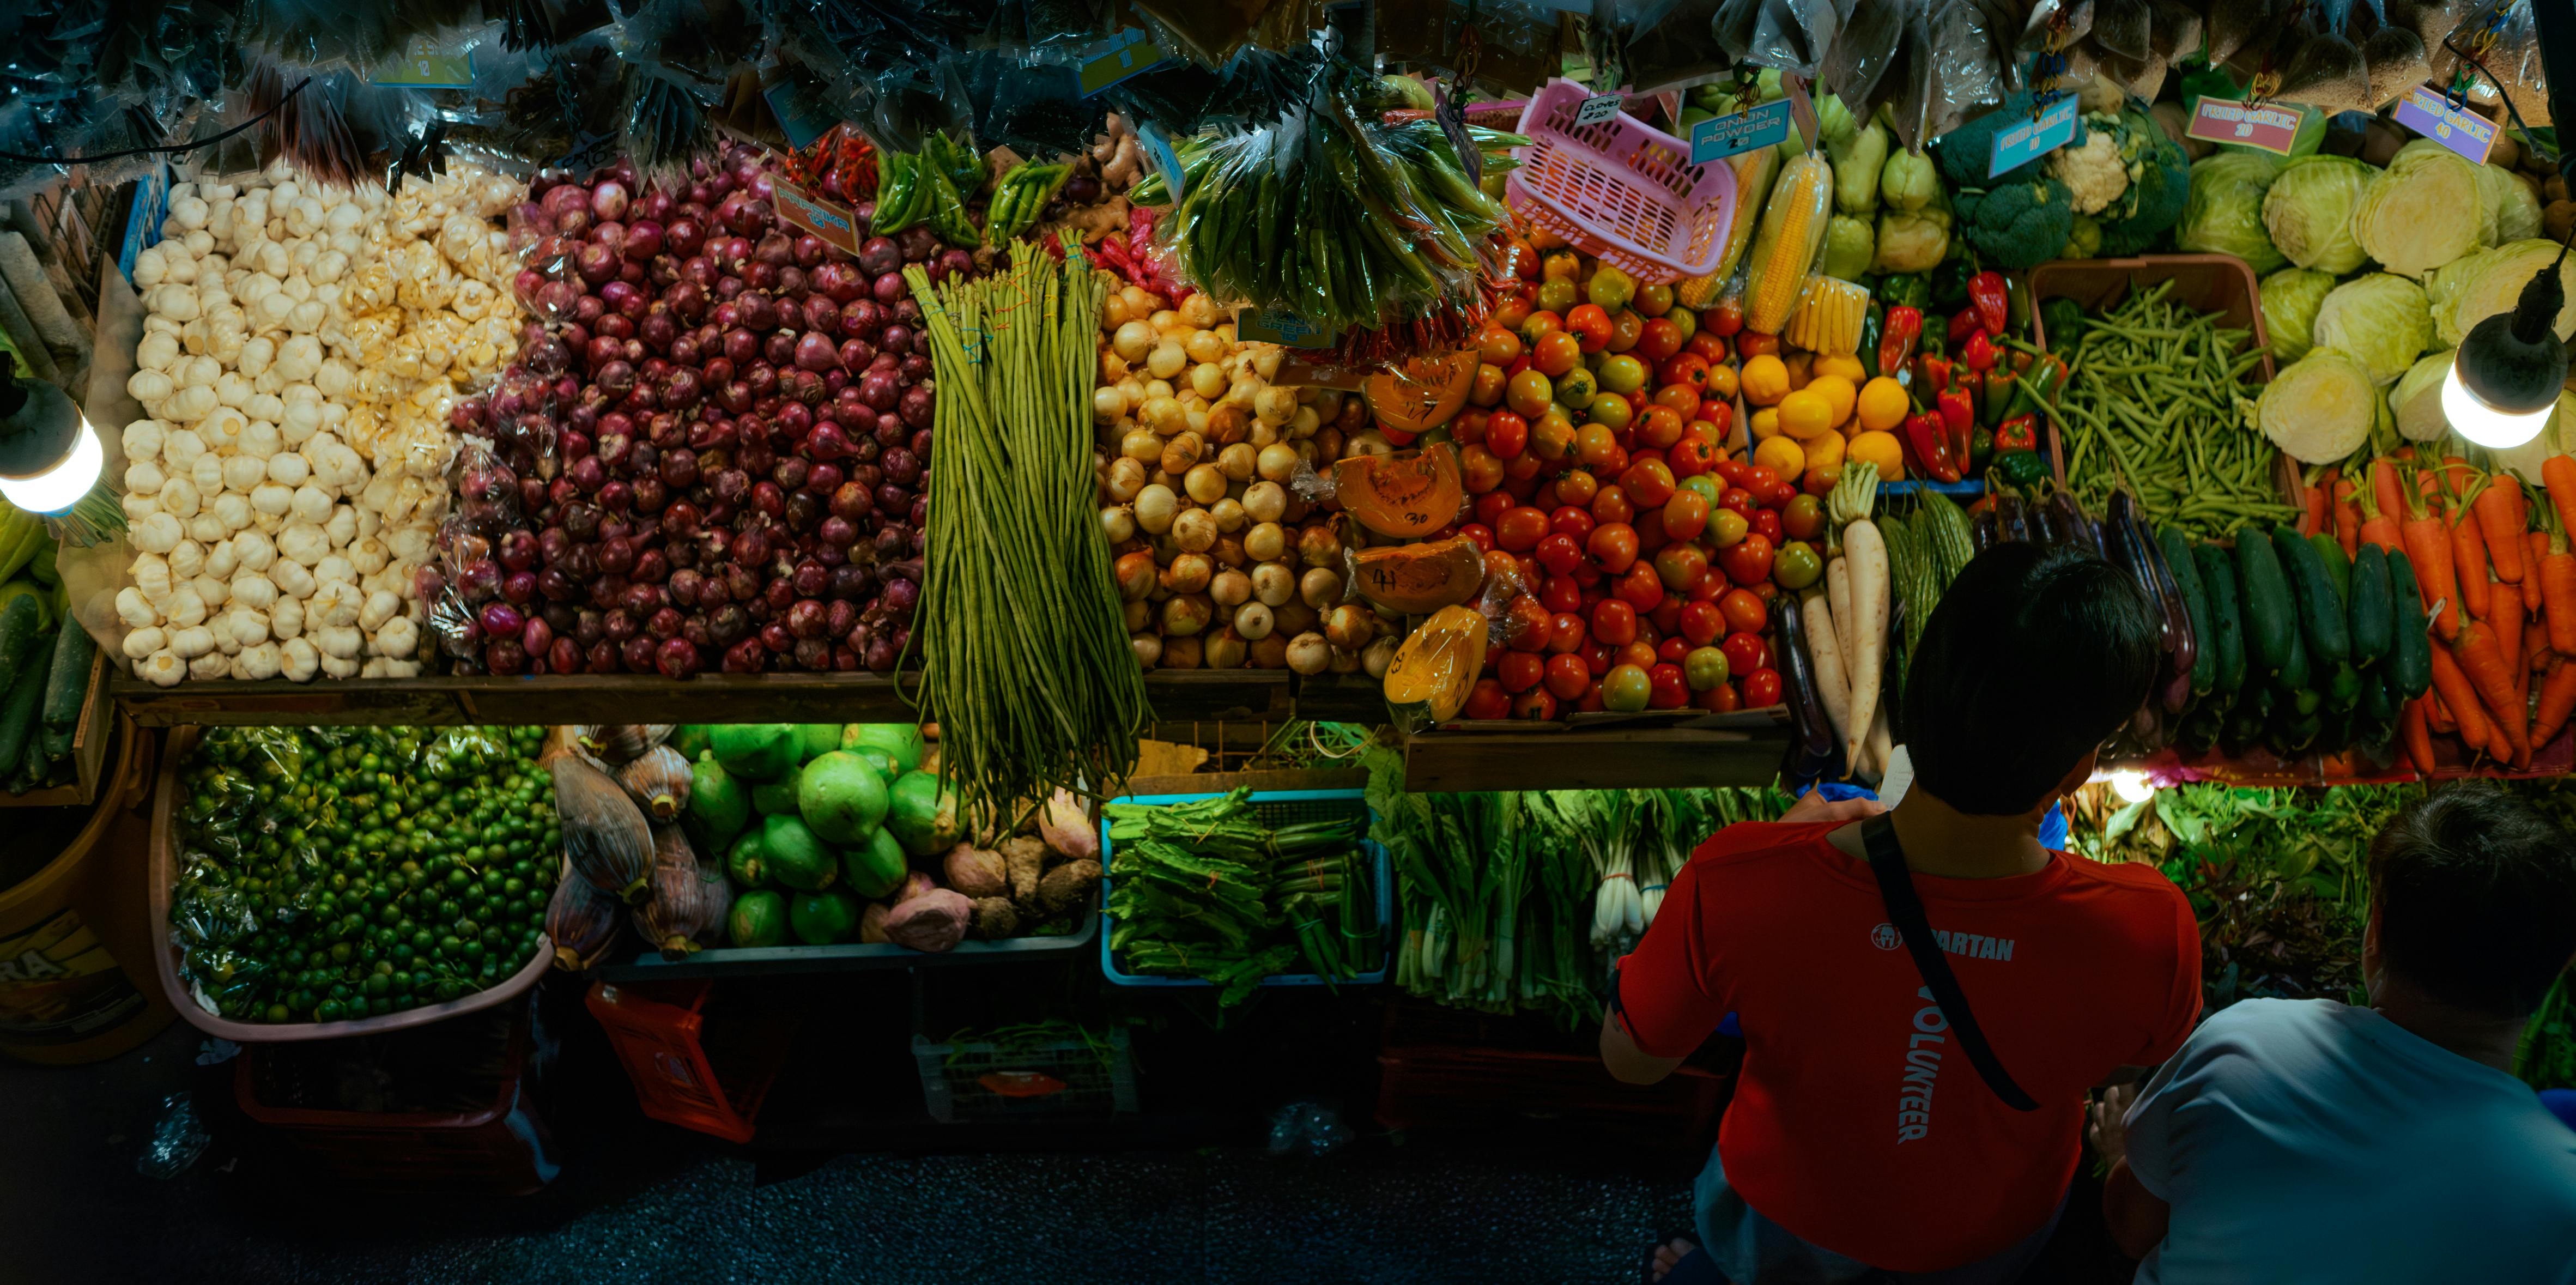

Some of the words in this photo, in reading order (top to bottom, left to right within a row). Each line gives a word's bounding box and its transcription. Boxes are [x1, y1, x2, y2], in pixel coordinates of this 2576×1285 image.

[1701, 116, 1781, 146] POWDER
[1715, 109, 1771, 131] ONION
[2000, 126, 2032, 152] FRIED
[2033, 105, 2073, 136] GARLIC
[2202, 104, 2245, 122] FRIED
[2244, 110, 2296, 130] GARLIC
[2235, 123, 2253, 136] 20
[2411, 92, 2445, 117] RIED
[2444, 110, 2492, 143] GARLIC
[2435, 122, 2451, 139] 40
[2029, 136, 2040, 152] 10
[777, 186, 850, 232] PAPRIKA
[1931, 928, 2015, 962] ARTAN
